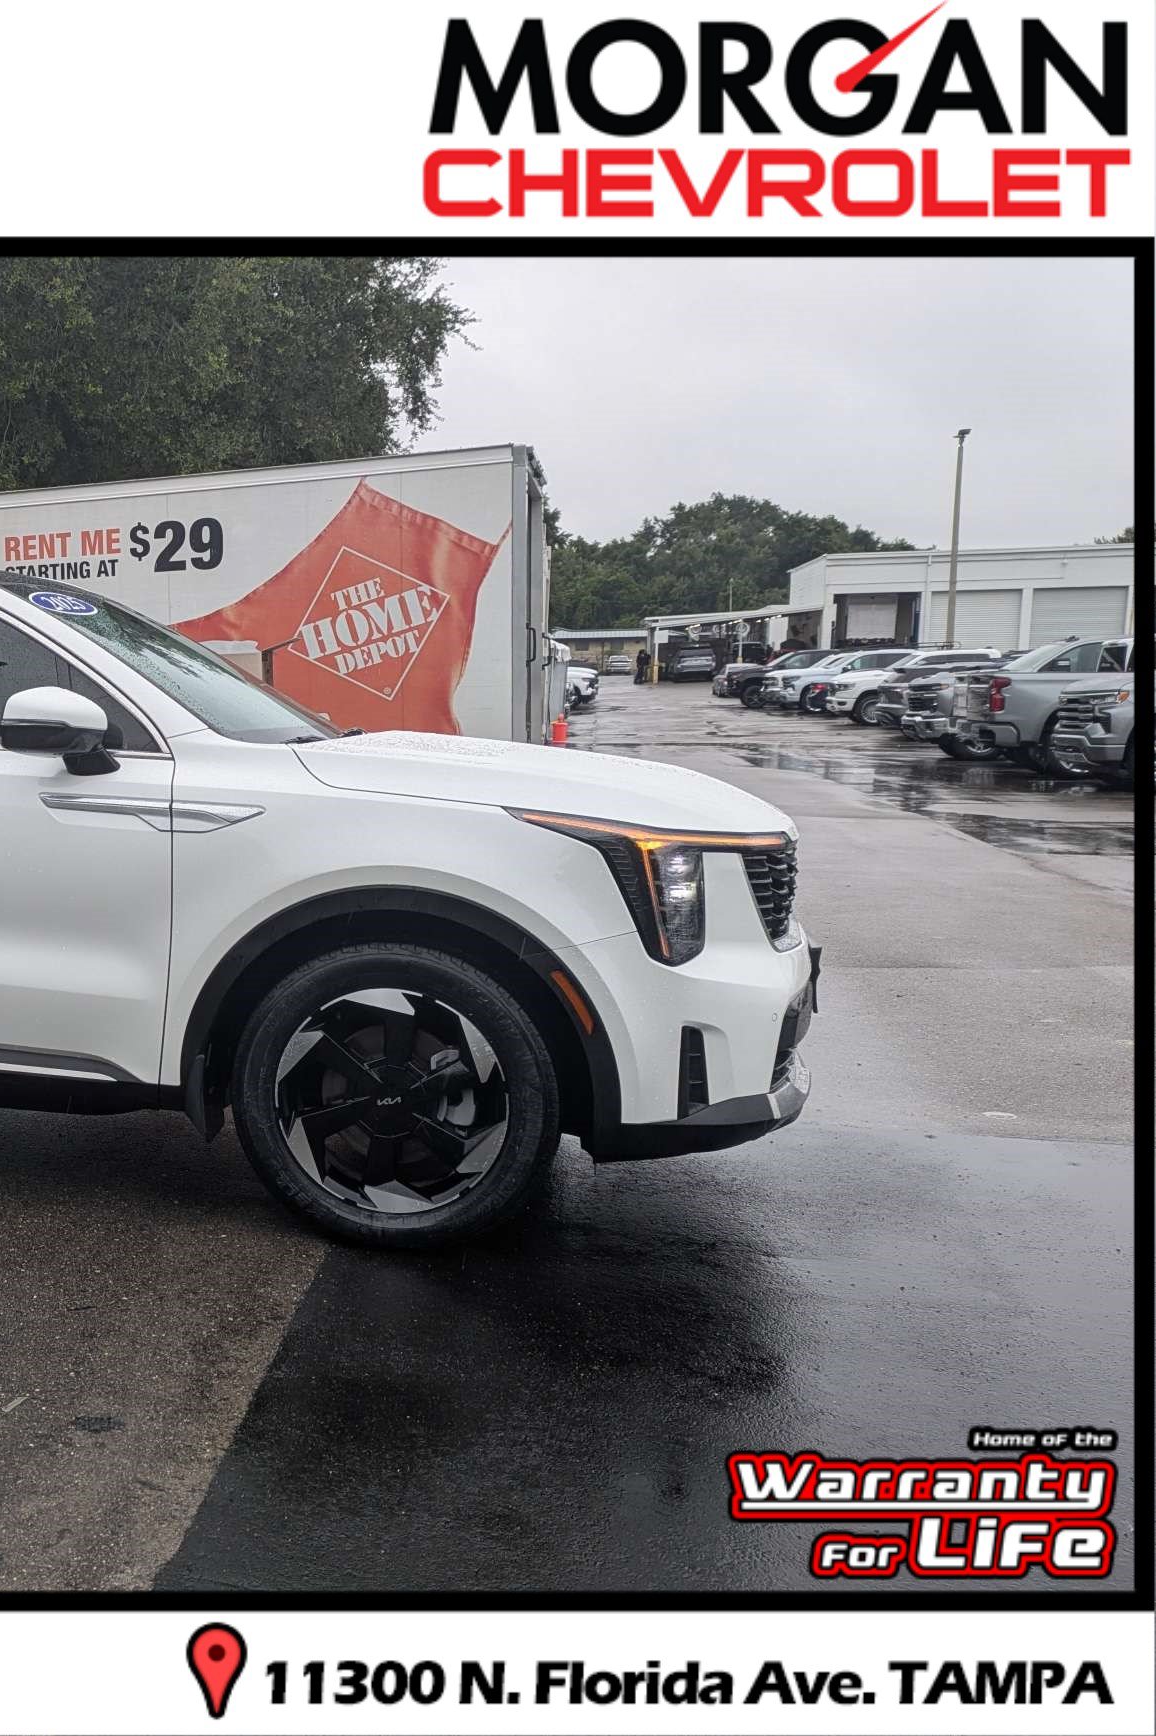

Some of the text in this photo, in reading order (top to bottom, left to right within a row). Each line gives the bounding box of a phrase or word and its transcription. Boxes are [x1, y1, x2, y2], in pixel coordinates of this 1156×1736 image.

[4, 528, 121, 561] RENT ME
[129, 517, 224, 573] $29
[96, 559, 119, 578] AT
[330, 577, 385, 611] THE
[300, 585, 439, 661] HOME
[334, 629, 420, 675] DEPOT
